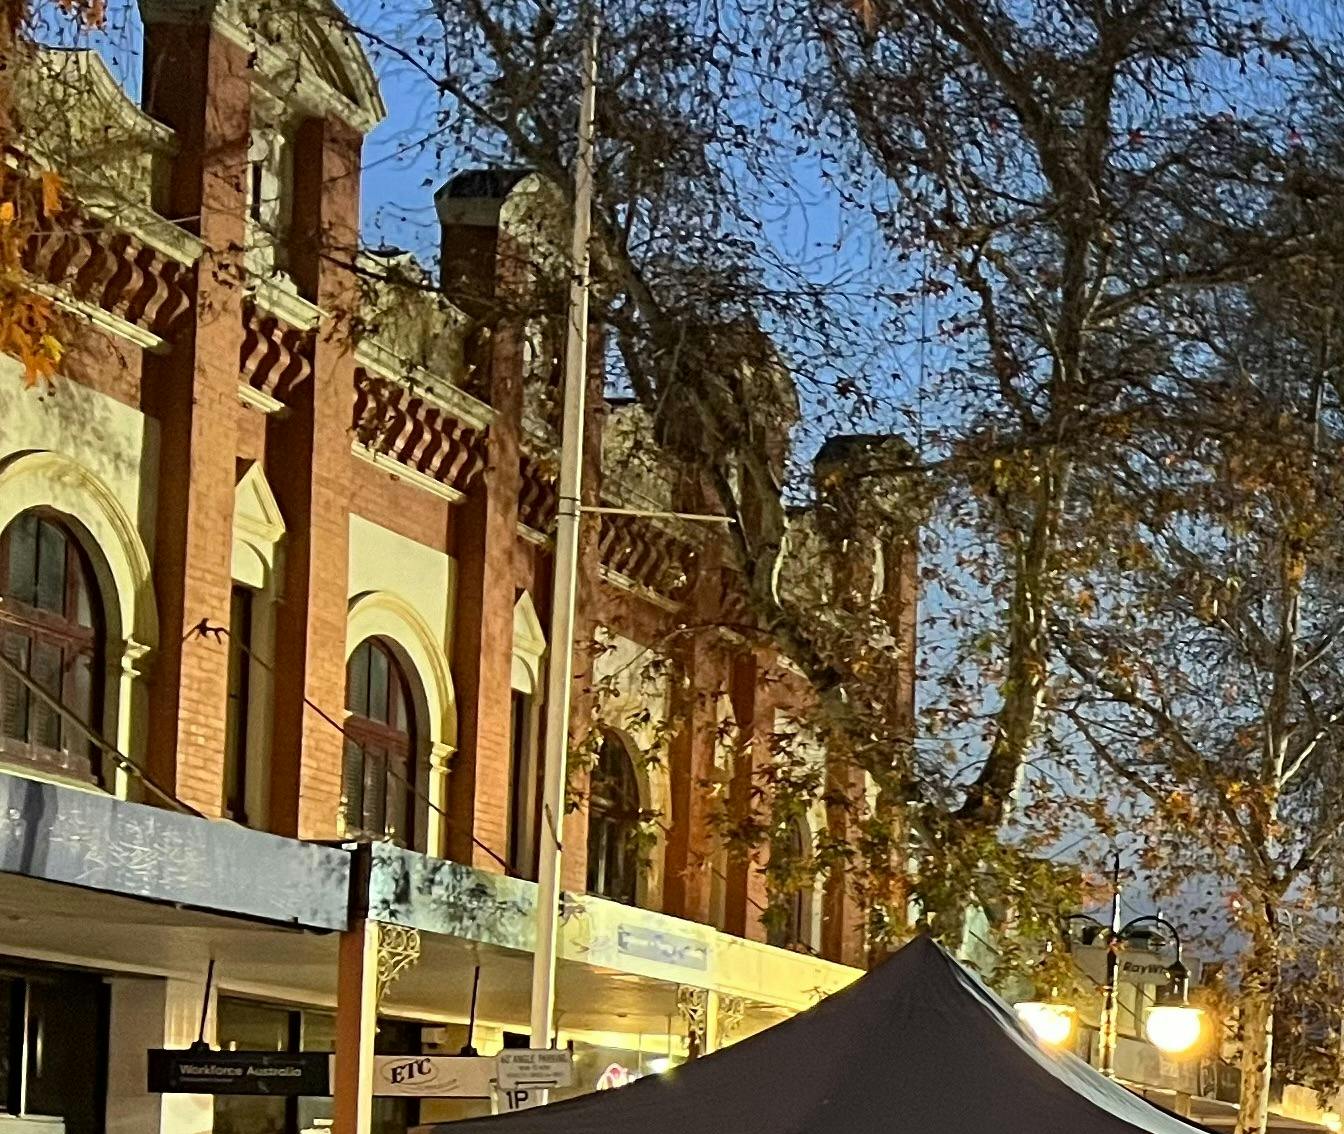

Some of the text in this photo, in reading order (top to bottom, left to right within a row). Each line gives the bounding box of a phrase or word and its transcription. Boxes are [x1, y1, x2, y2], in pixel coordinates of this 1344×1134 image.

[178, 1063, 302, 1077] Workforce Australia
[390, 1057, 432, 1085] ETC
[506, 1090, 529, 1109] 1P
